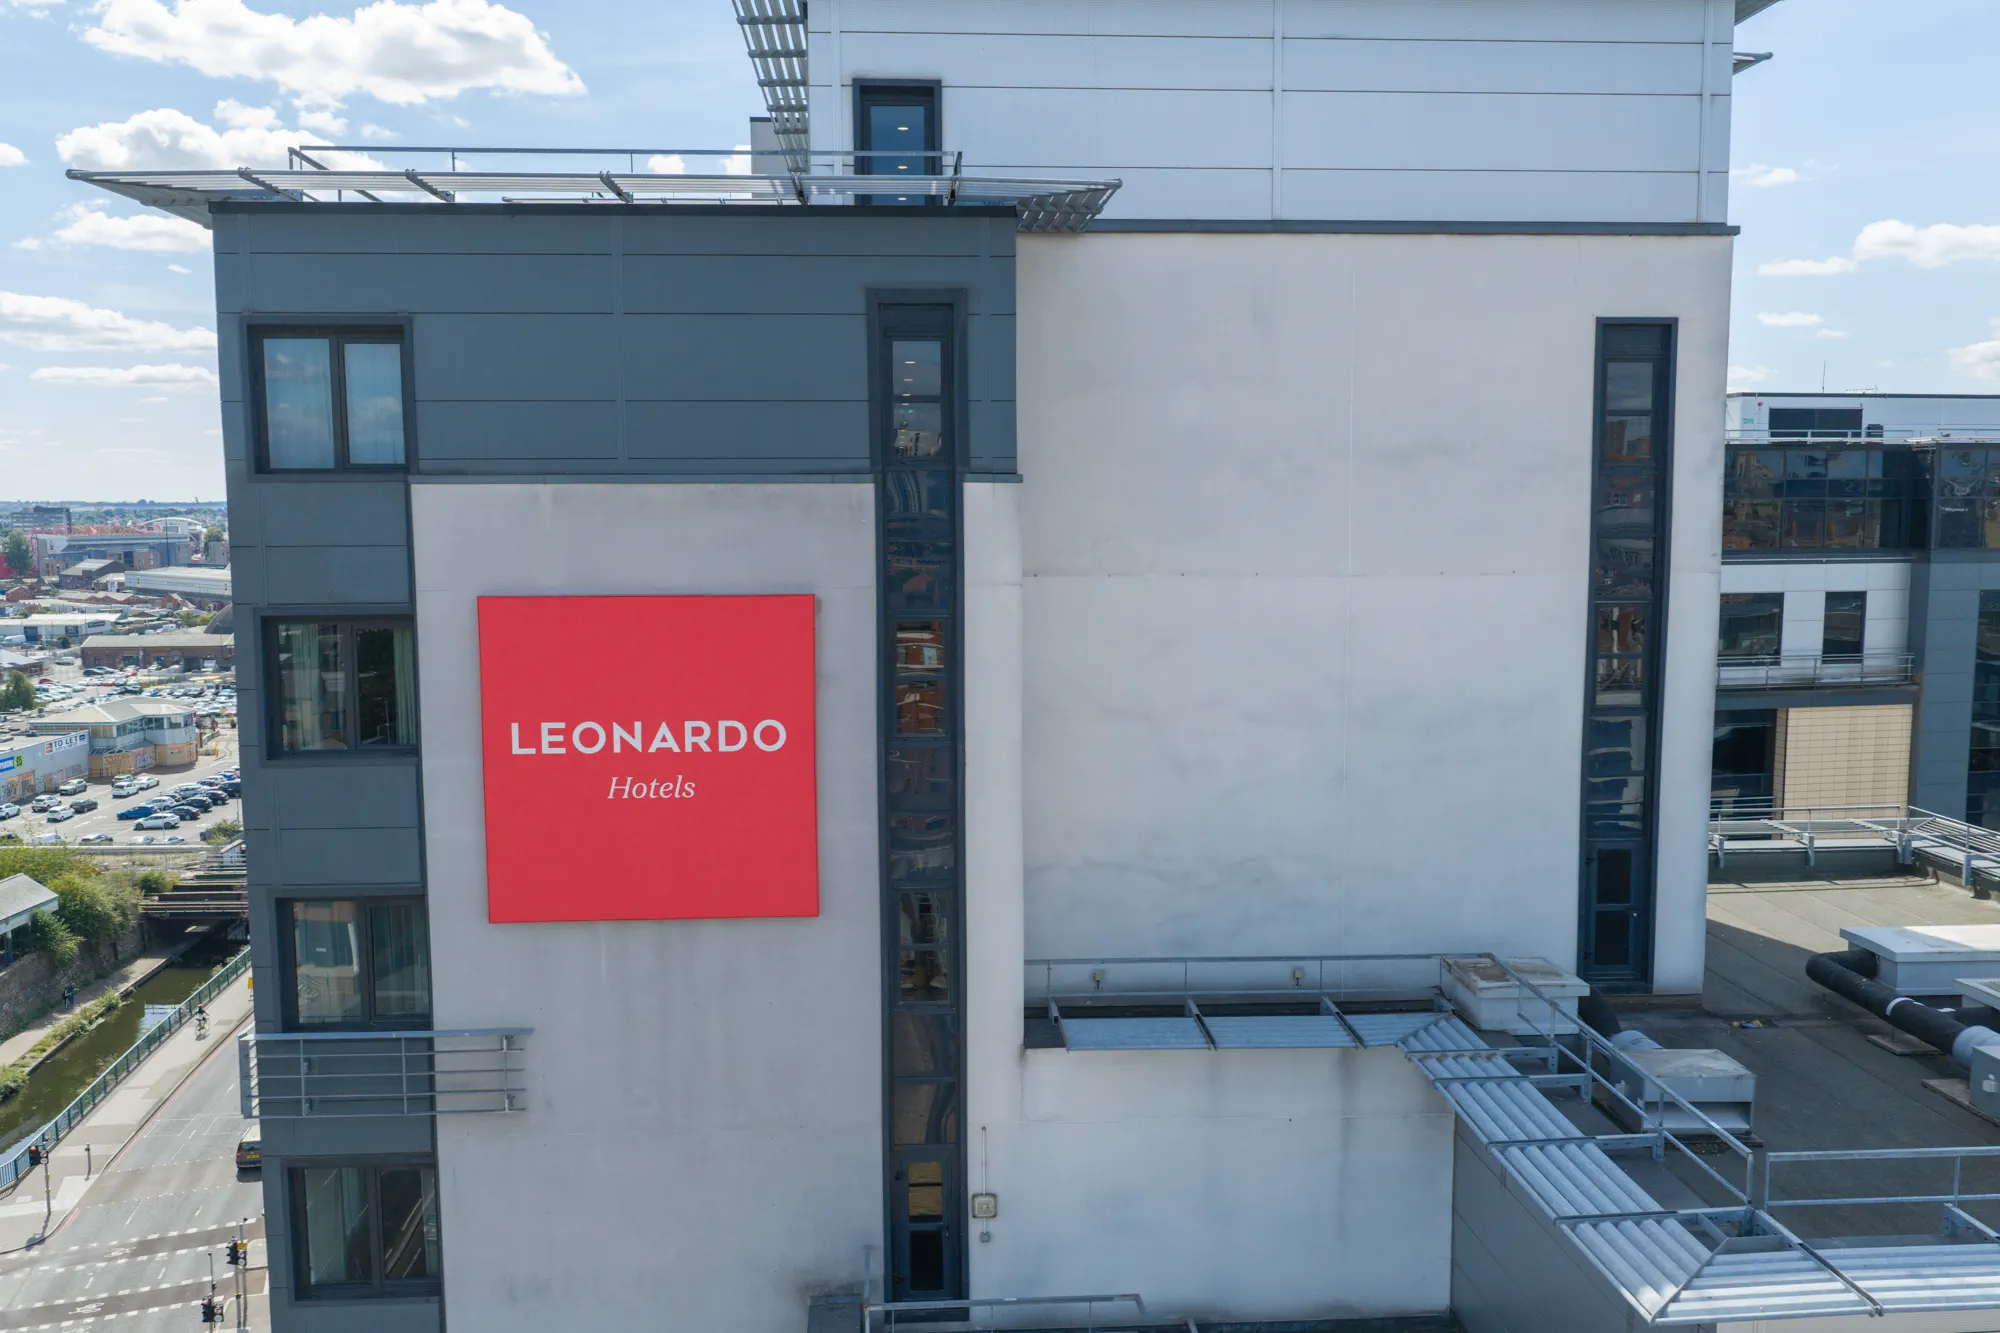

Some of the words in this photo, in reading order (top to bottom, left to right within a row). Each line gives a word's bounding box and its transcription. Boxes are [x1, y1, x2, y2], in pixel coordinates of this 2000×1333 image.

[53, 740, 63, 748] TO
[65, 735, 78, 745] LET
[511, 719, 787, 755] LEONARDO
[607, 774, 696, 799] Hotels
